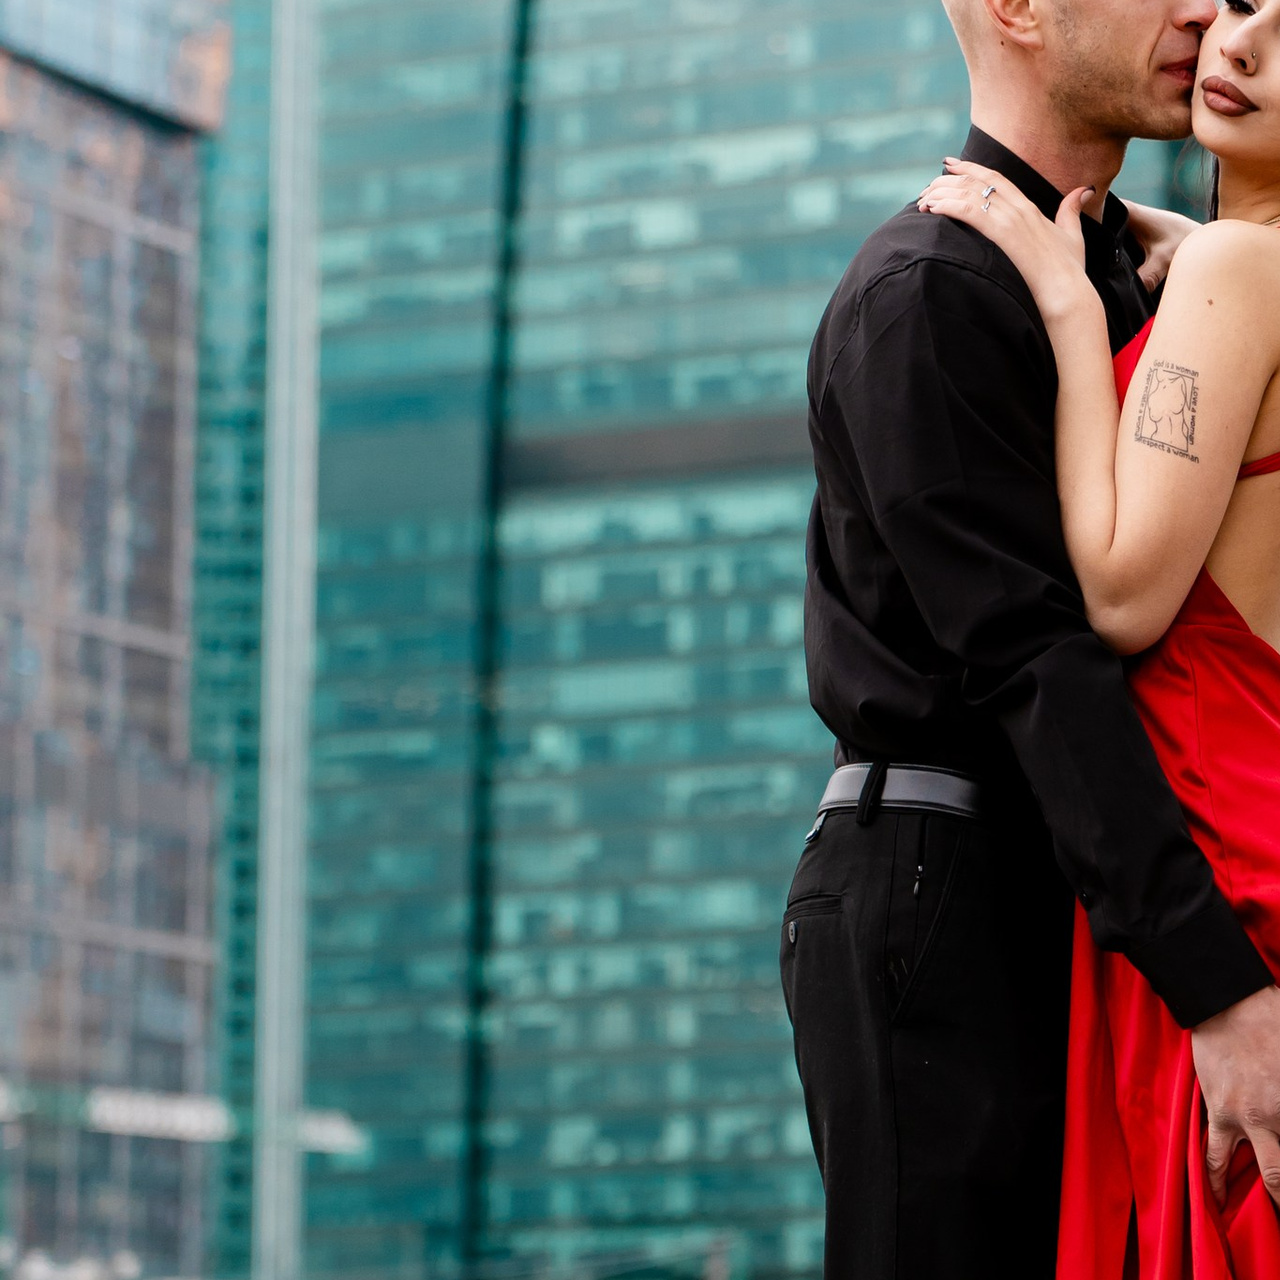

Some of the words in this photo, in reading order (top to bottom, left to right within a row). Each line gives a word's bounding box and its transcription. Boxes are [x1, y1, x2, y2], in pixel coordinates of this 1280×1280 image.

[1153, 359, 1164, 368] God
[1175, 365, 1199, 378] woman
[1172, 449, 1199, 463] woman
